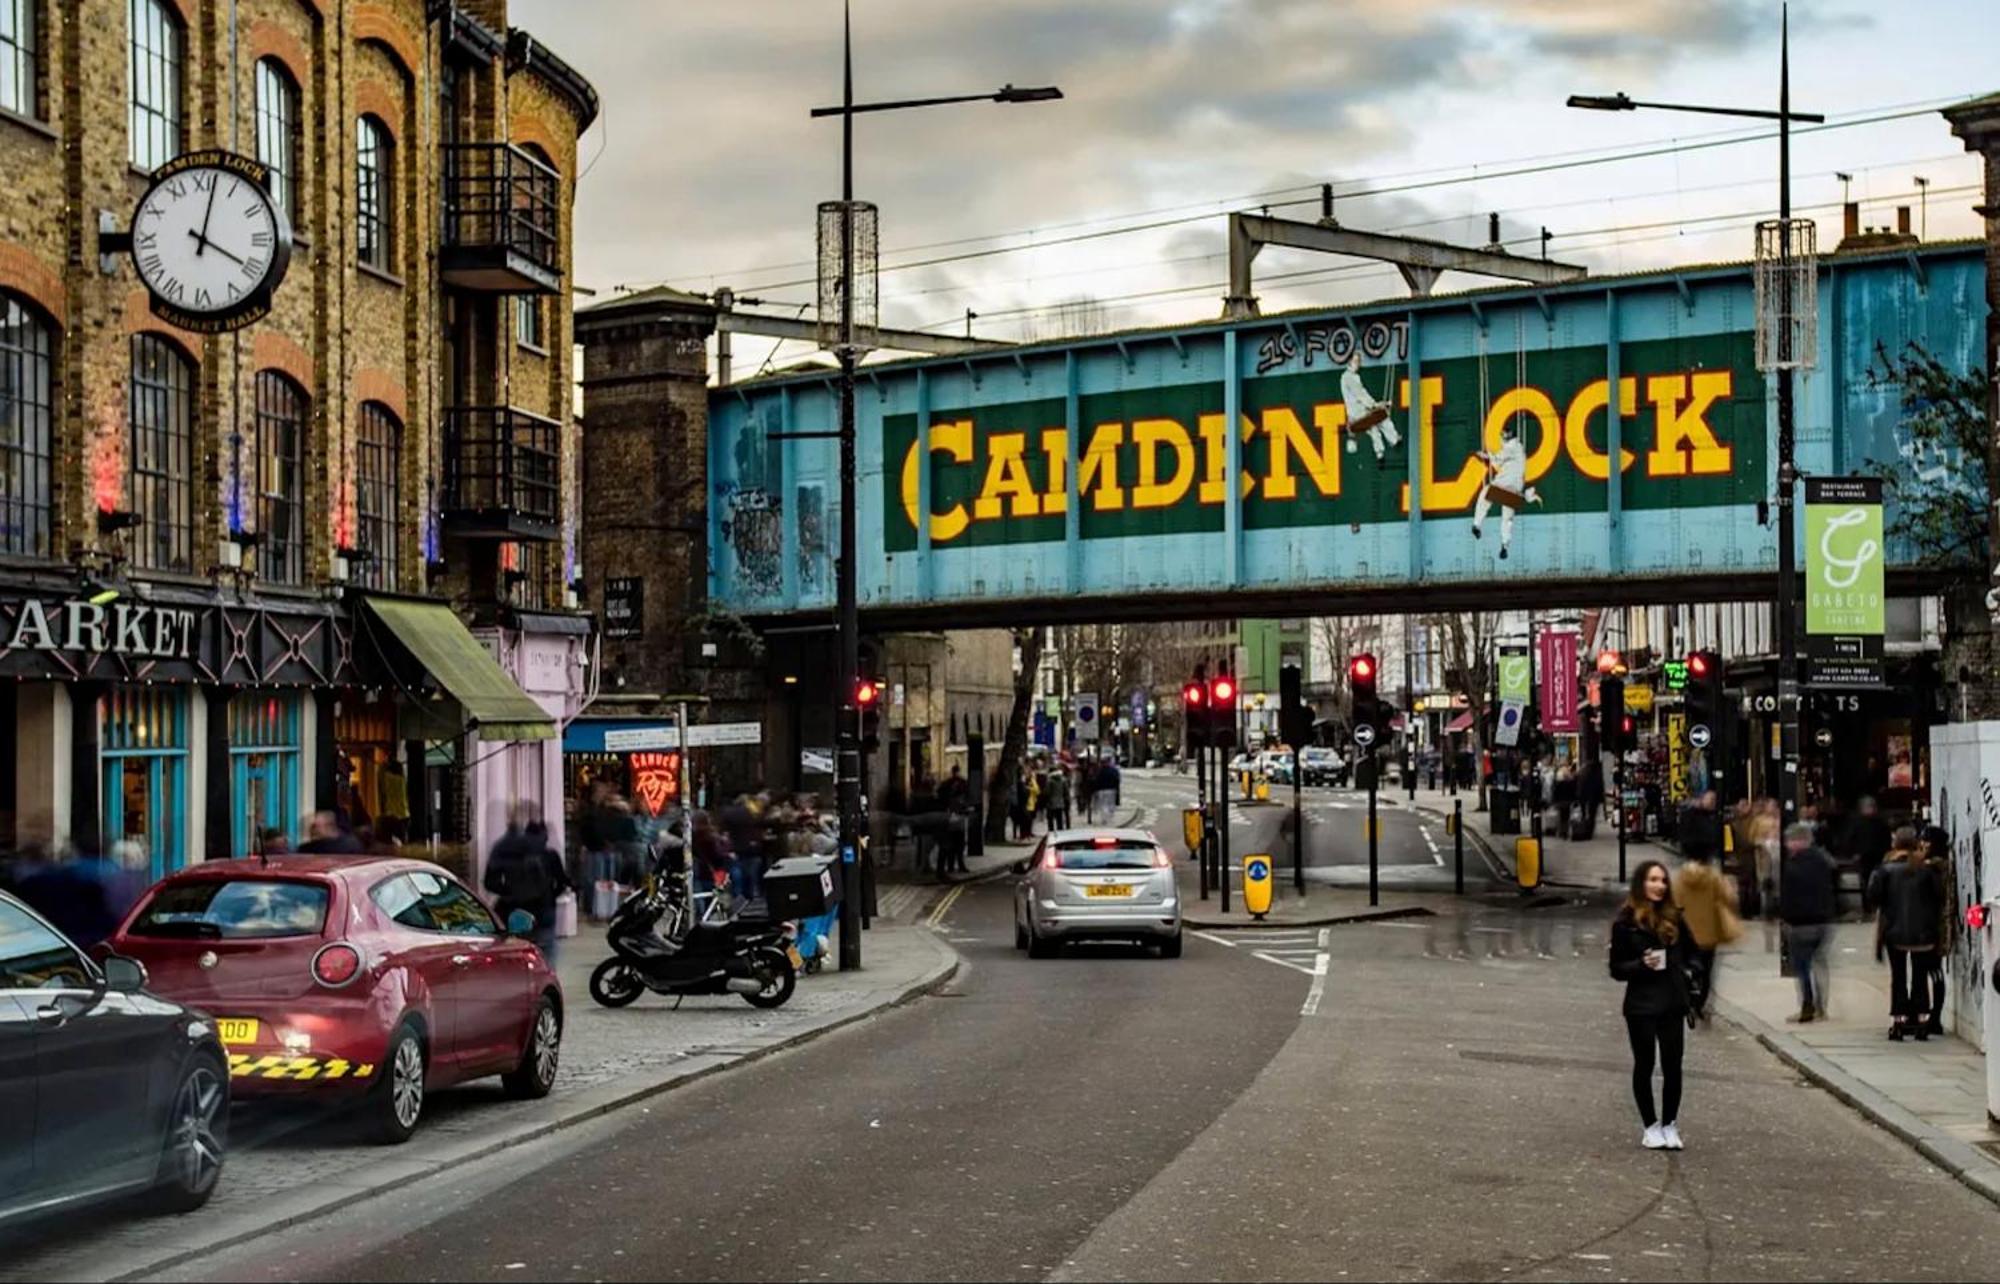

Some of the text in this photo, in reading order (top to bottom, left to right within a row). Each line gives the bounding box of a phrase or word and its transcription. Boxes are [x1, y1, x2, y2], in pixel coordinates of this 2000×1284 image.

[225, 155, 264, 180] LOCK
[226, 306, 264, 329] HALL
[1304, 320, 1409, 367] FOOT
[901, 370, 1731, 541] CAMDEN LOCK
[1811, 591, 1878, 609] GABETO
